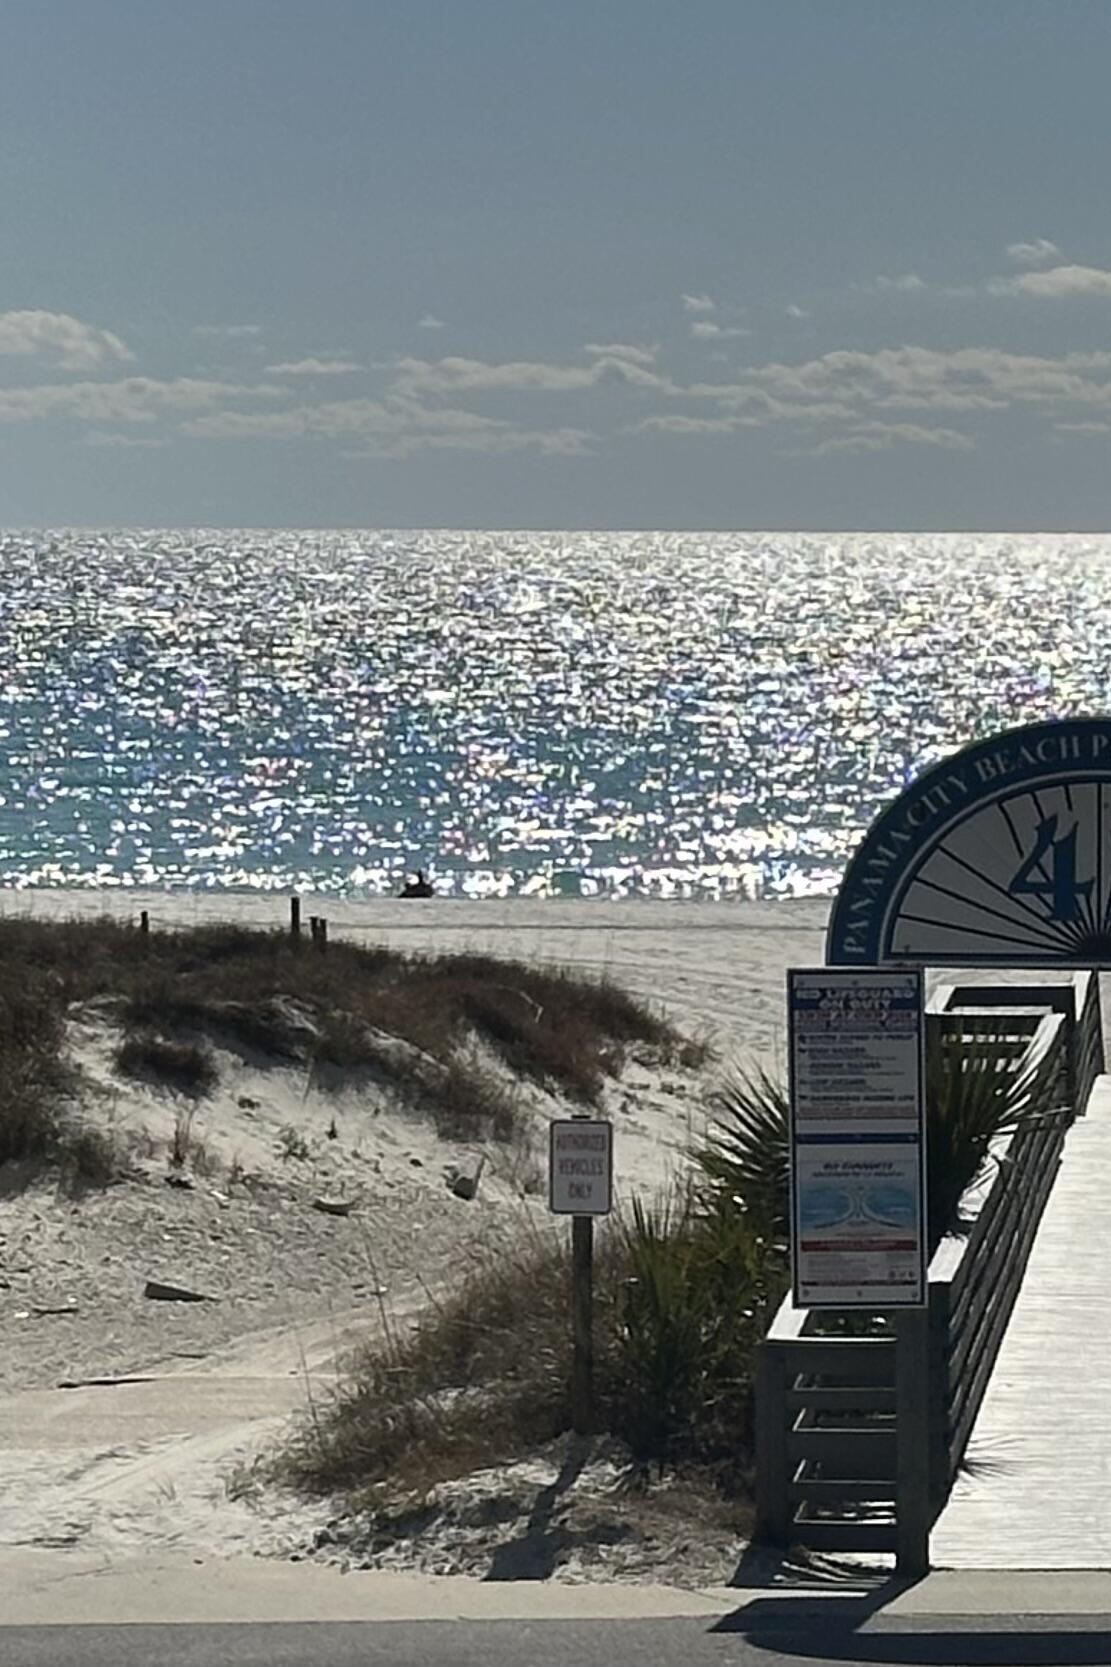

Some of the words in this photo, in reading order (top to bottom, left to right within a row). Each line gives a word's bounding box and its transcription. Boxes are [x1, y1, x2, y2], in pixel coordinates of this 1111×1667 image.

[843, 830, 912, 953] PANAMA
[906, 772, 968, 826] CITY
[974, 735, 1081, 782] BEACH
